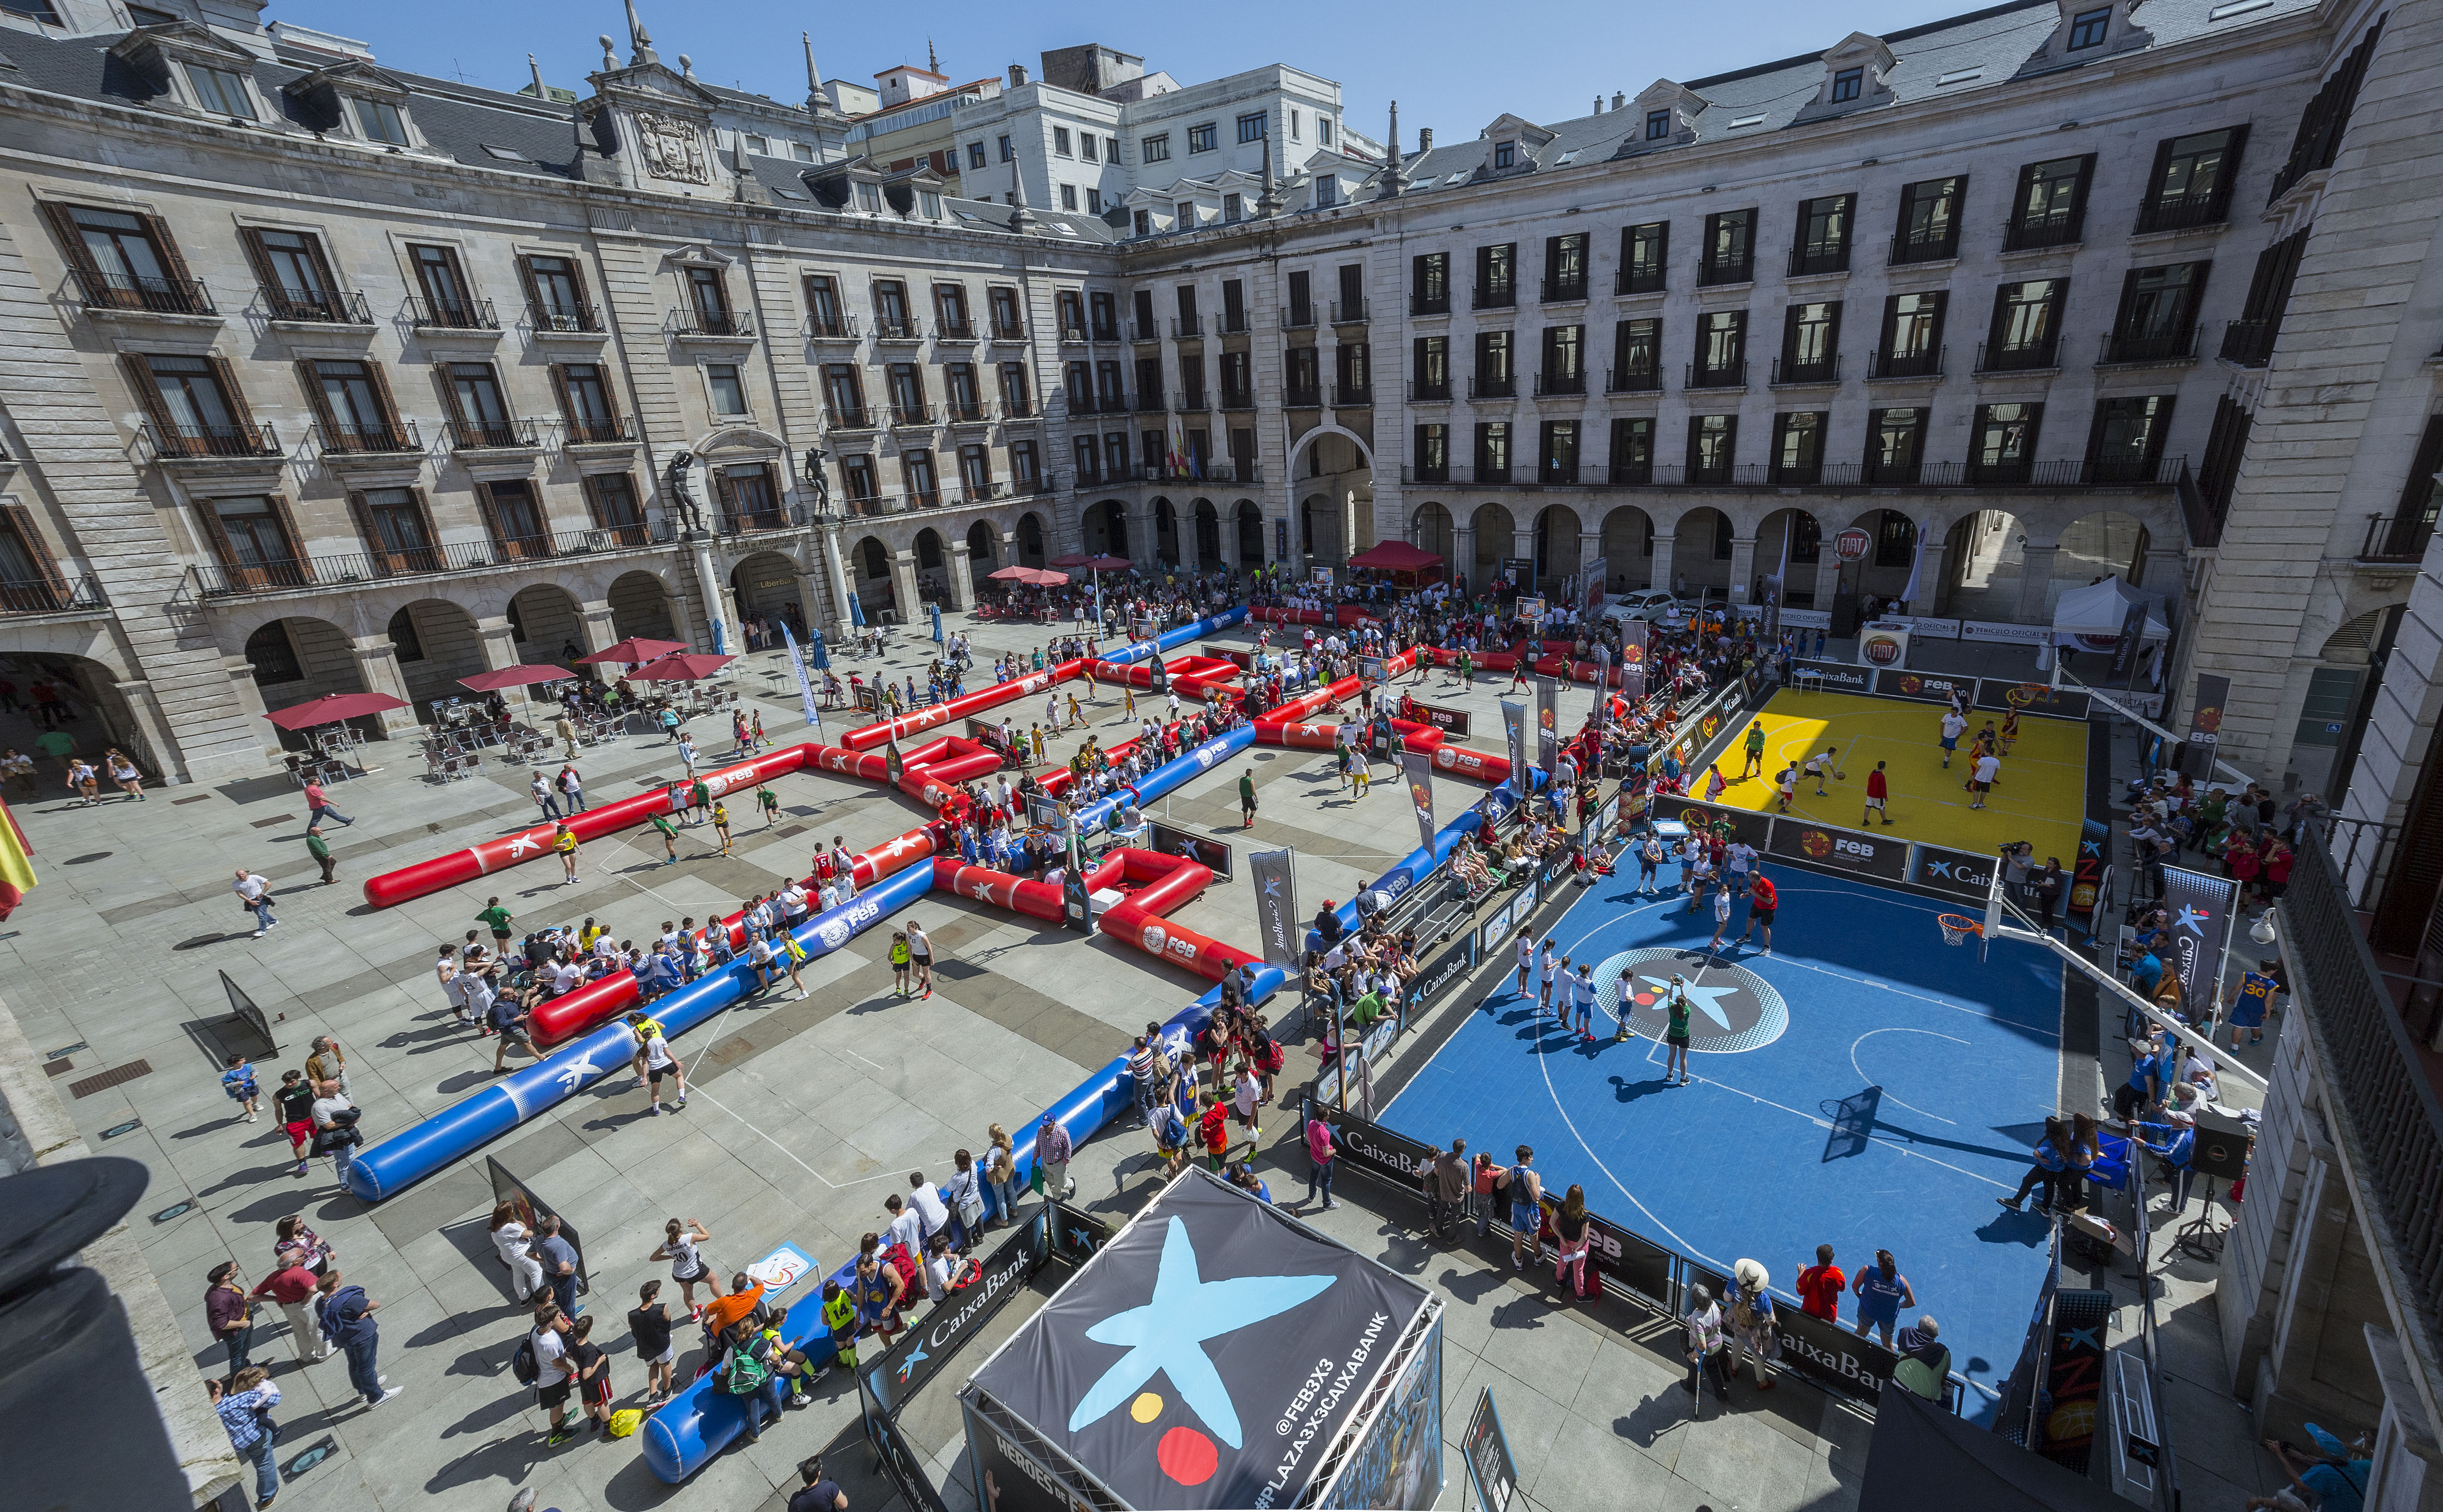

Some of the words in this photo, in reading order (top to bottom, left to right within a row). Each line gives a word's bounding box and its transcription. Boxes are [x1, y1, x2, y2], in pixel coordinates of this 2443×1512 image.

[727, 542, 749, 550] CAJA
[759, 535, 795, 546] AHORROS
[735, 548, 766, 556] SANTANDER
[769, 542, 796, 550] CANTABRIA
[1840, 538, 1864, 553] FIAT
[1873, 644, 1893, 659] FIAT
[1956, 689, 1967, 698] 10
[821, 858, 827, 867] 5
[596, 941, 601, 952] 5
[1424, 952, 1467, 996] CaixaBank
[2244, 983, 2266, 998] 30
[285, 1089, 310, 1101] CELTICS
[1347, 1132, 1425, 1180] CaixaBa
[931, 1248, 1029, 1347] CaixaBank
[833, 1303, 849, 1320] 14
[1777, 1321, 1884, 1392] aixaBa
[1276, 1358, 1334, 1436] @FEB3X3
[1253, 1311, 1388, 1510] #PLAZA3X3CAIXABANK
[1055, 1486, 1067, 1504] DE
